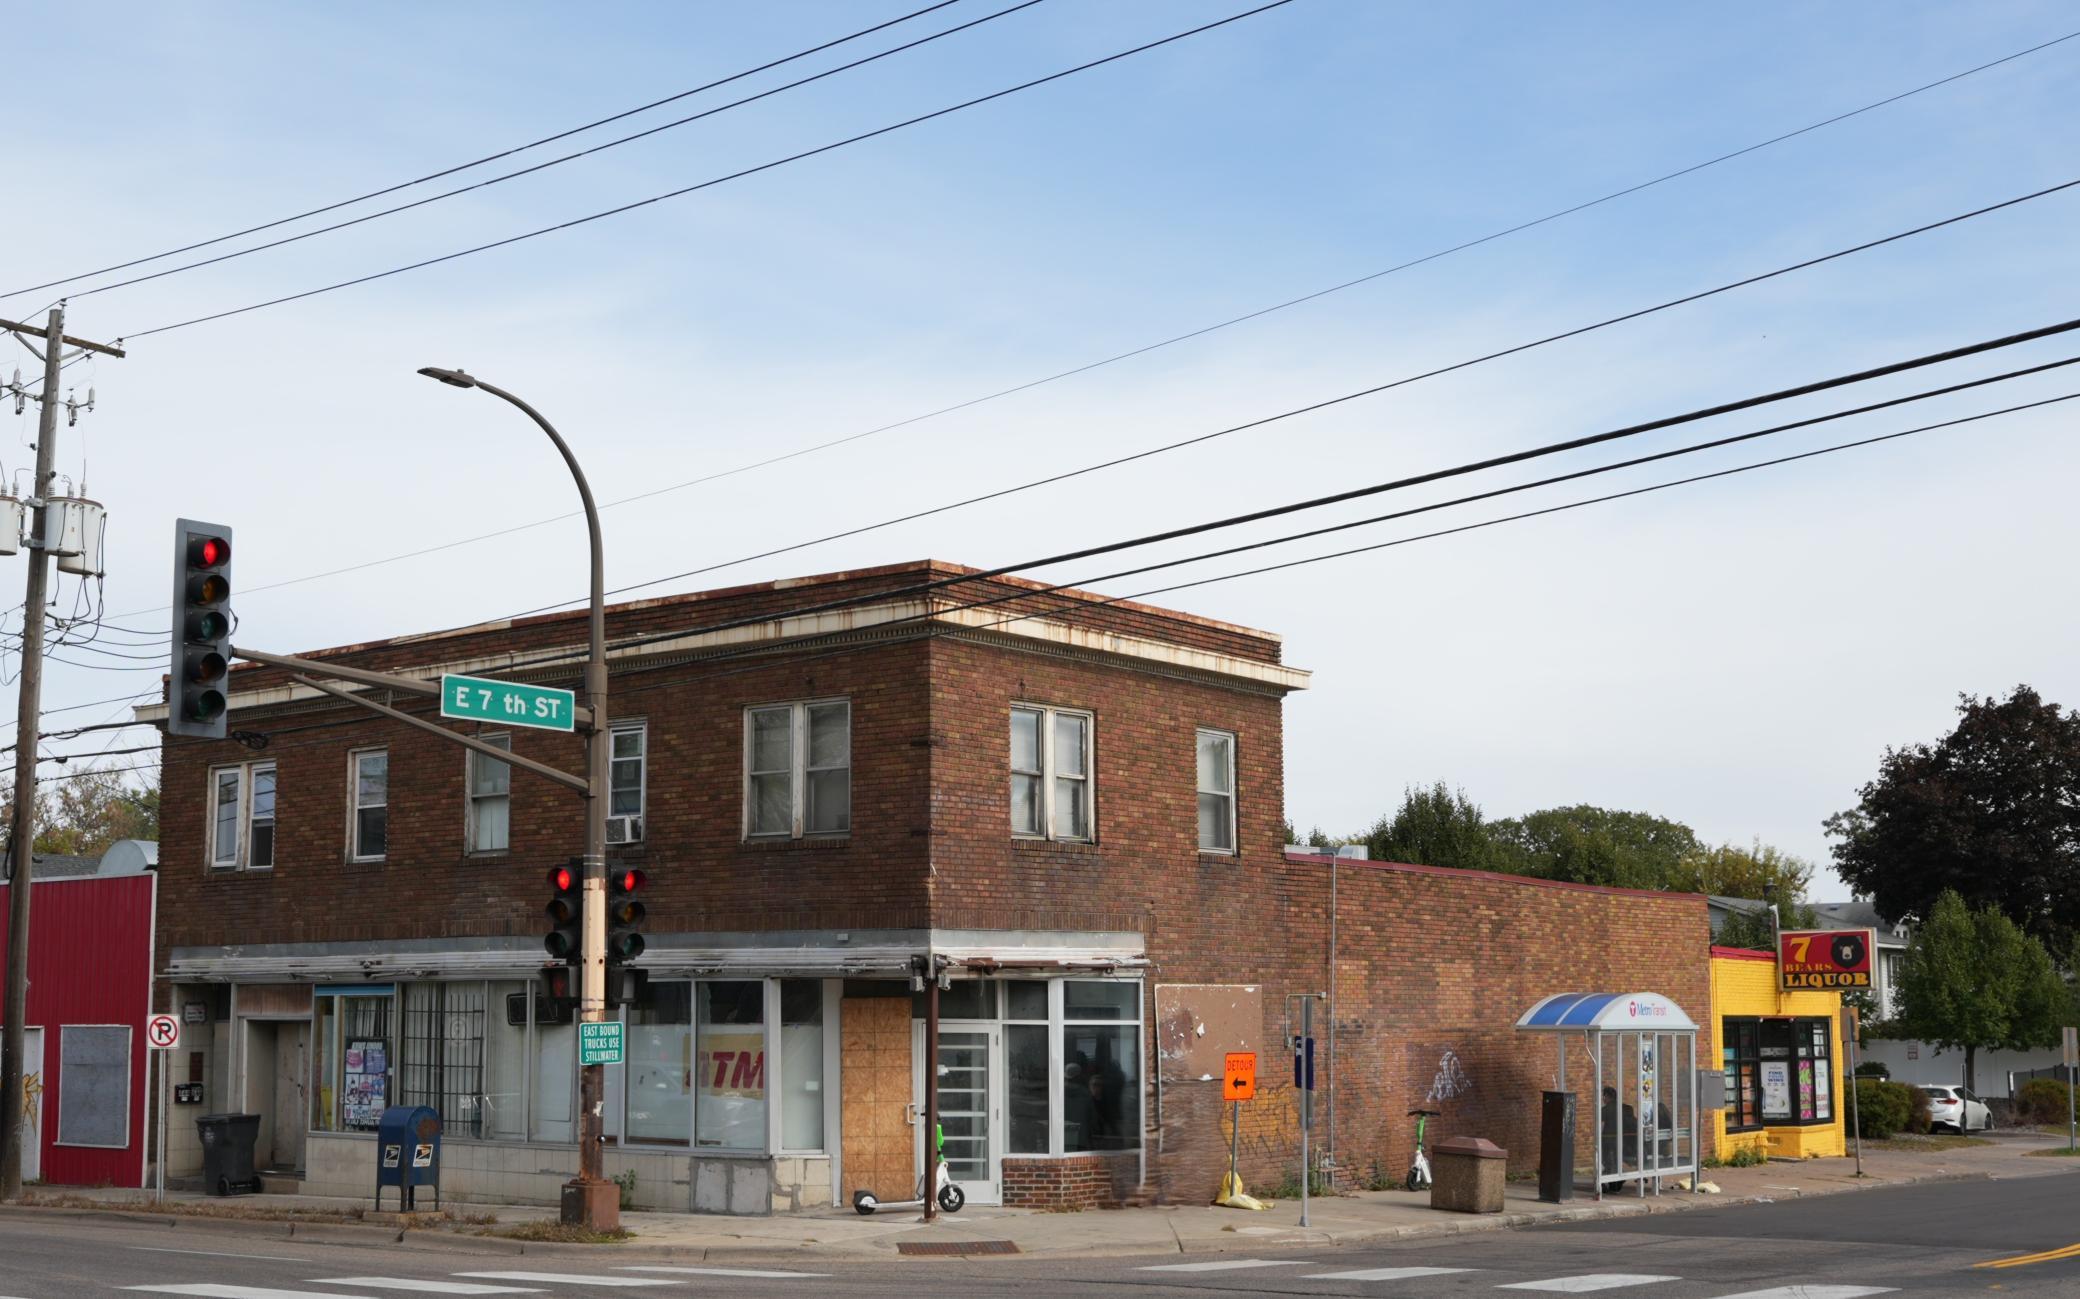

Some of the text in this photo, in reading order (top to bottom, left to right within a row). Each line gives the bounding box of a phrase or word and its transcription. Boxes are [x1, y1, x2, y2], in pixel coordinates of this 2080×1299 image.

[456, 686, 561, 719] E 7 th ST
[1790, 937, 1811, 963] 7
[1785, 963, 1832, 972] BEARS
[1785, 972, 1869, 988] LIQUOR
[584, 1025, 619, 1036] EAST BOUND
[584, 1037, 619, 1049] TRUCKS USE
[585, 1050, 619, 1062] STILLWATER
[1227, 1060, 1253, 1072] DETOUR
